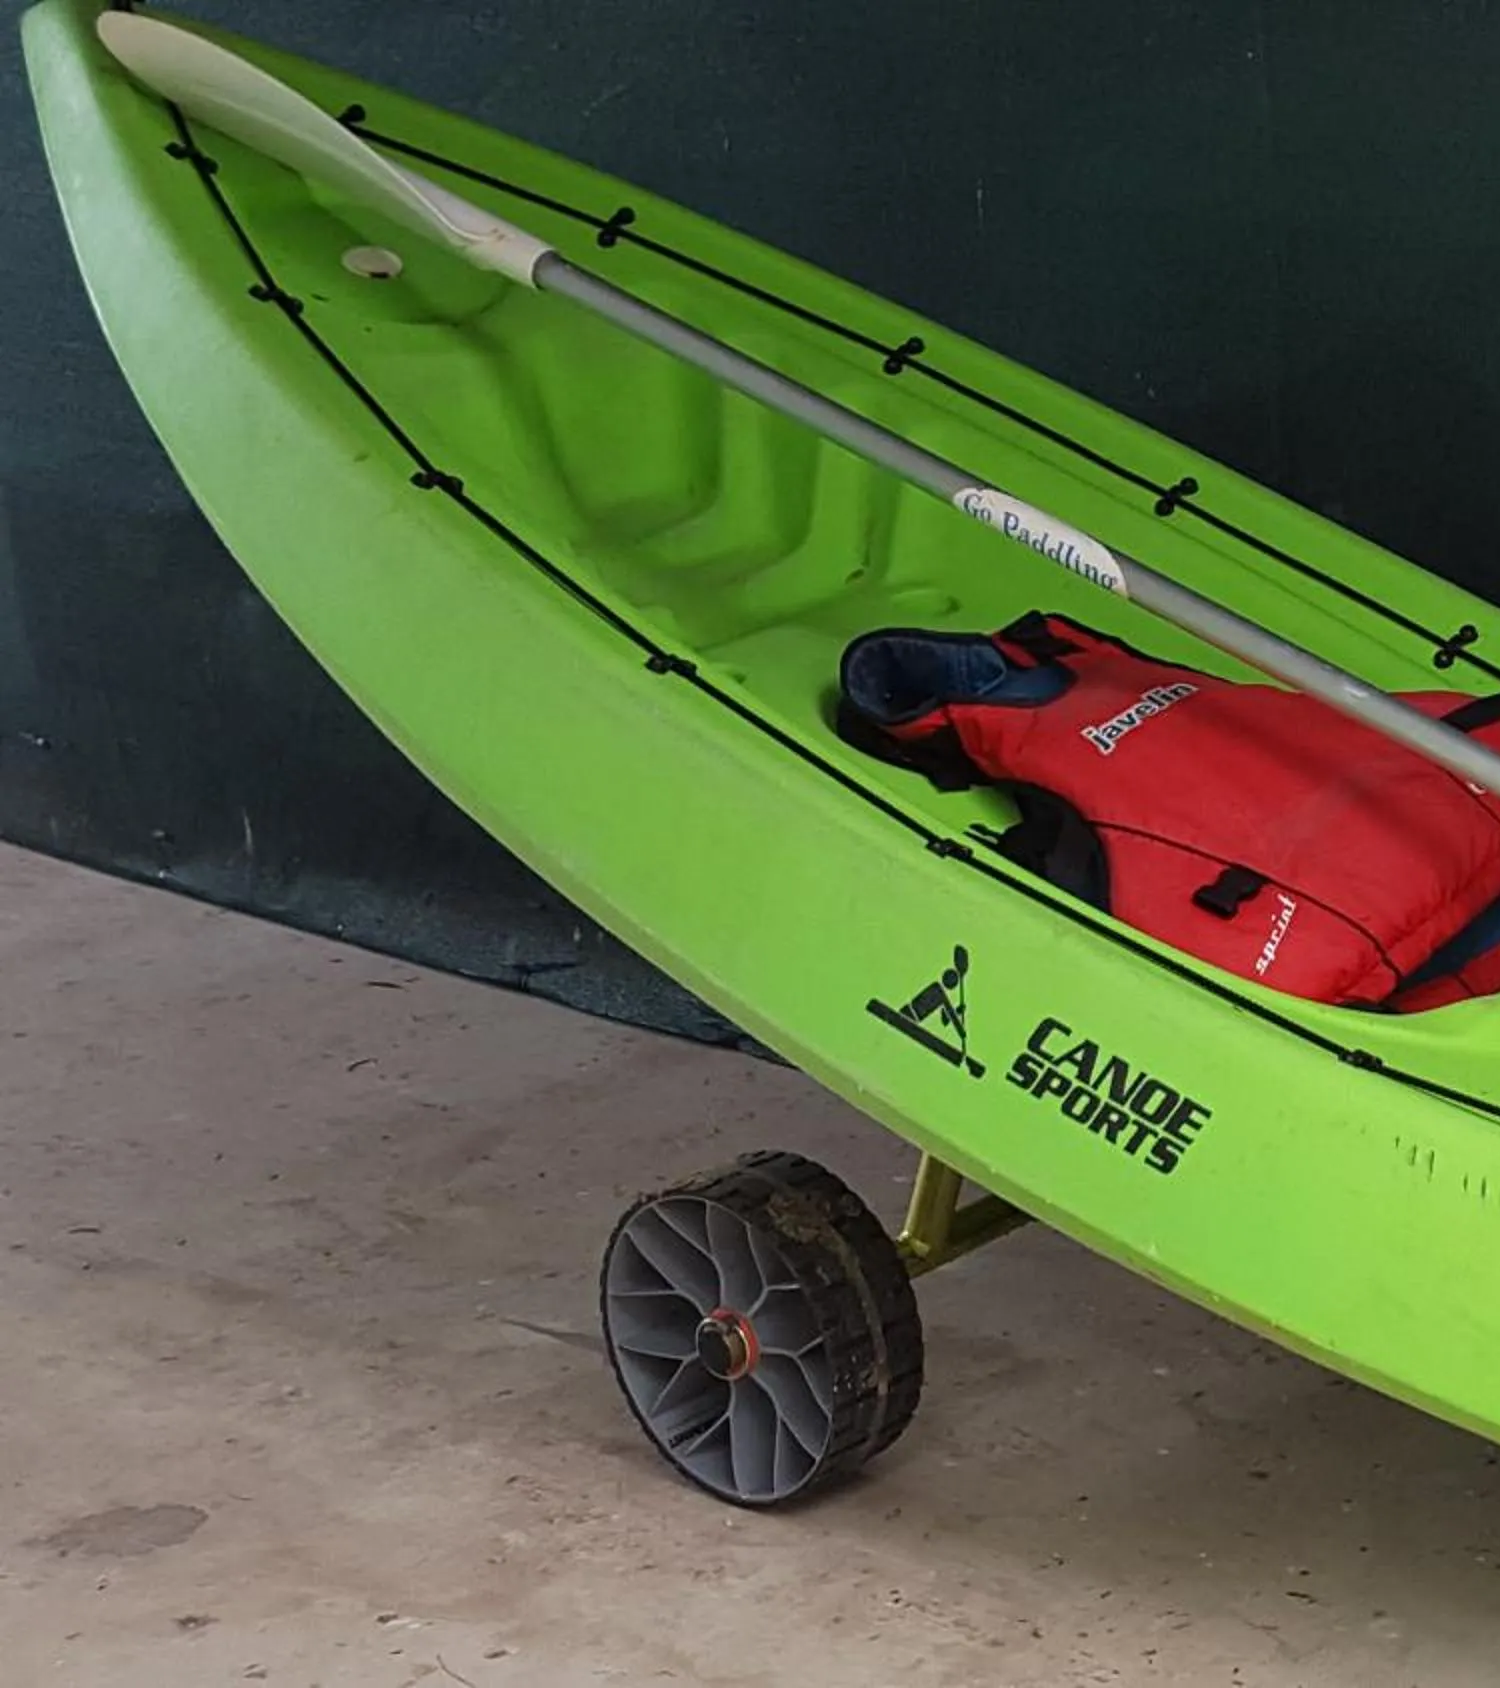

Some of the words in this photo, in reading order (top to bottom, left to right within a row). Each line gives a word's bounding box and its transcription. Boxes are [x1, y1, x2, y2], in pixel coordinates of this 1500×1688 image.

[962, 493, 993, 523] Go
[1003, 510, 1119, 590] Paddling
[1080, 682, 1199, 756] javelin
[1254, 892, 1298, 977] sprint
[1005, 1050, 1190, 1175] SPORTS
[1026, 1016, 1213, 1146] CANOE
